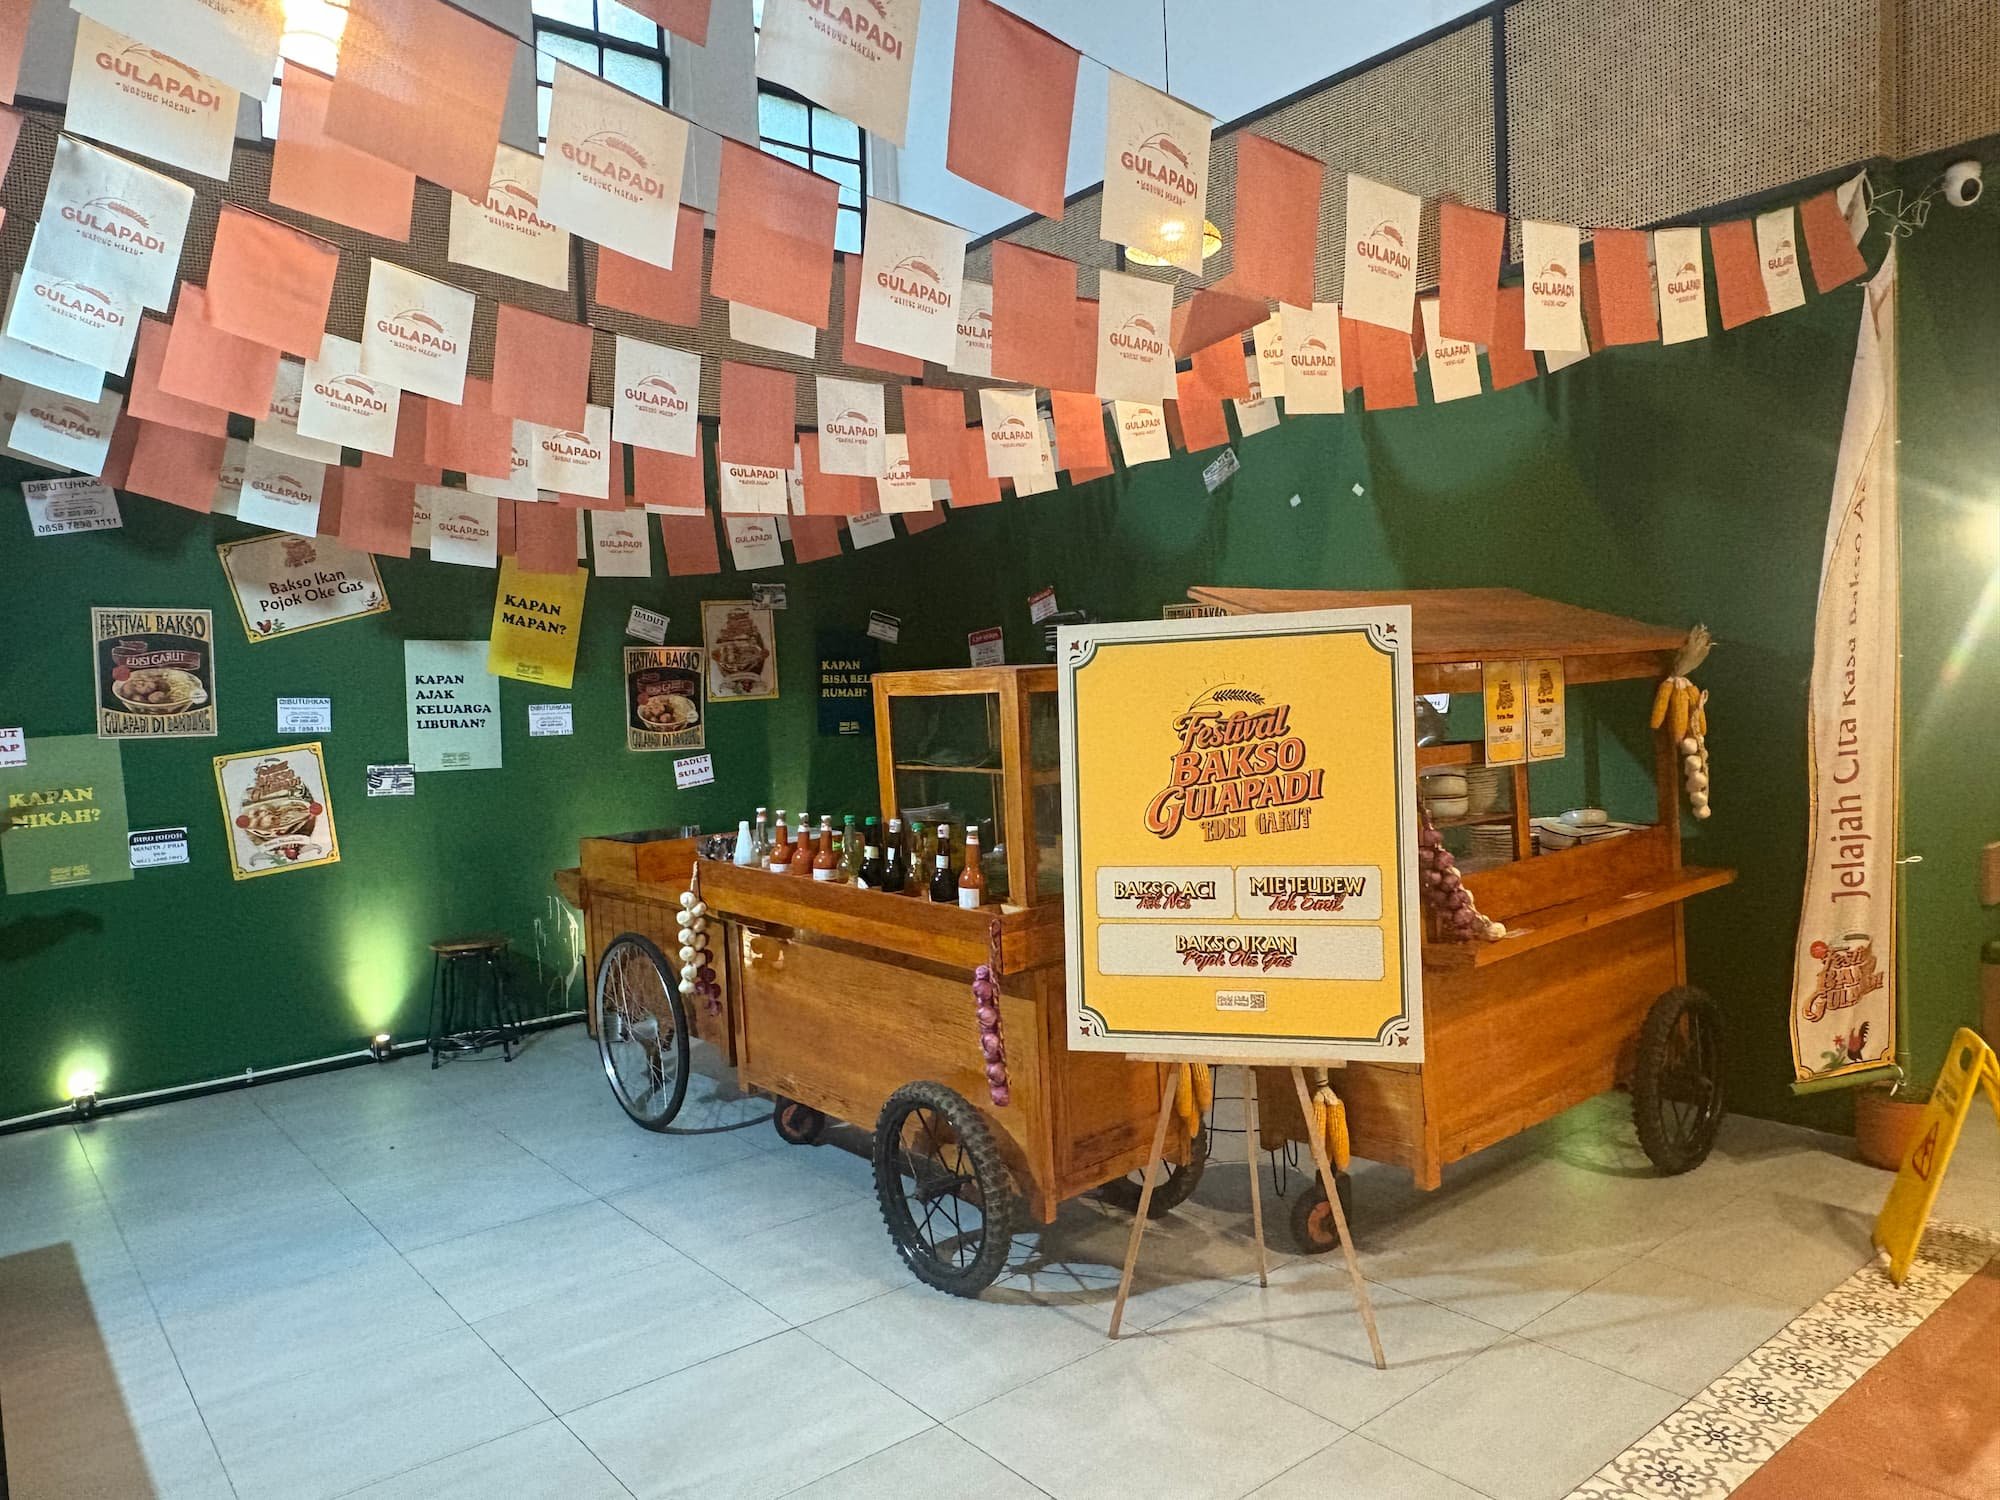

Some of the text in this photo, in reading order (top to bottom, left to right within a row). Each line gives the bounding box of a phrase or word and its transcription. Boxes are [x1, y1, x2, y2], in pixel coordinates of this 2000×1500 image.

[96, 53, 220, 112] GULAPADI
[561, 142, 664, 200] GULAPADI
[1121, 151, 1198, 199] GULAPADI
[61, 206, 166, 254] GULAPADI
[1357, 241, 1411, 272] GULAPADI
[877, 271, 952, 308] GULAPADI
[1532, 281, 1575, 298] GULAPADI
[34, 284, 125, 327] GULAPADI
[377, 320, 457, 355] GULAPADI
[1110, 332, 1163, 355] GULAPADI
[1291, 355, 1336, 367] GULAPADI
[314, 383, 387, 414] GULAPADI
[625, 388, 688, 412] GULAPADI
[30, 406, 101, 438] GULAPADI
[826, 423, 878, 438] GULAPADI
[991, 431, 1033, 441] GULAPADI
[542, 440, 601, 460] GULAPADI
[729, 467, 779, 479] GULAPADI
[252, 480, 312, 503] GULAPADI
[439, 522, 490, 537] GULAPADI
[269, 570, 345, 595] Bakso Ikan
[260, 580, 364, 612] Pojok Oke Gas
[504, 594, 561, 616] KAPAN
[100, 613, 206, 639] FESTIVAL BAKSO
[502, 612, 567, 636] MAPAN?
[634, 610, 665, 627] BADUT
[821, 660, 861, 670] KAPAN
[415, 674, 465, 685] KAPAN
[822, 674, 872, 684] BISA BEL
[415, 689, 455, 700] AJAK
[822, 688, 868, 698] RUMAH?
[416, 704, 492, 715] KELUARGA
[416, 718, 486, 730] LIBURAN?
[1172, 703, 1291, 754] Festival
[1833, 717, 1860, 784] Cita
[677, 756, 709, 768] BADUT
[678, 766, 710, 778] SULAP
[1171, 737, 1306, 788] BAKSO
[8, 787, 94, 809] KAPAN
[1144, 768, 1325, 840] GULAPADI
[11, 808, 102, 829] NIKAH?
[1200, 806, 1312, 842] EDISI GARUT
[1830, 794, 1872, 904] Jelajah
[1114, 880, 1216, 900] BAKSO ACI
[1249, 876, 1287, 897] MIE
[1176, 934, 1242, 954] BAKSO
